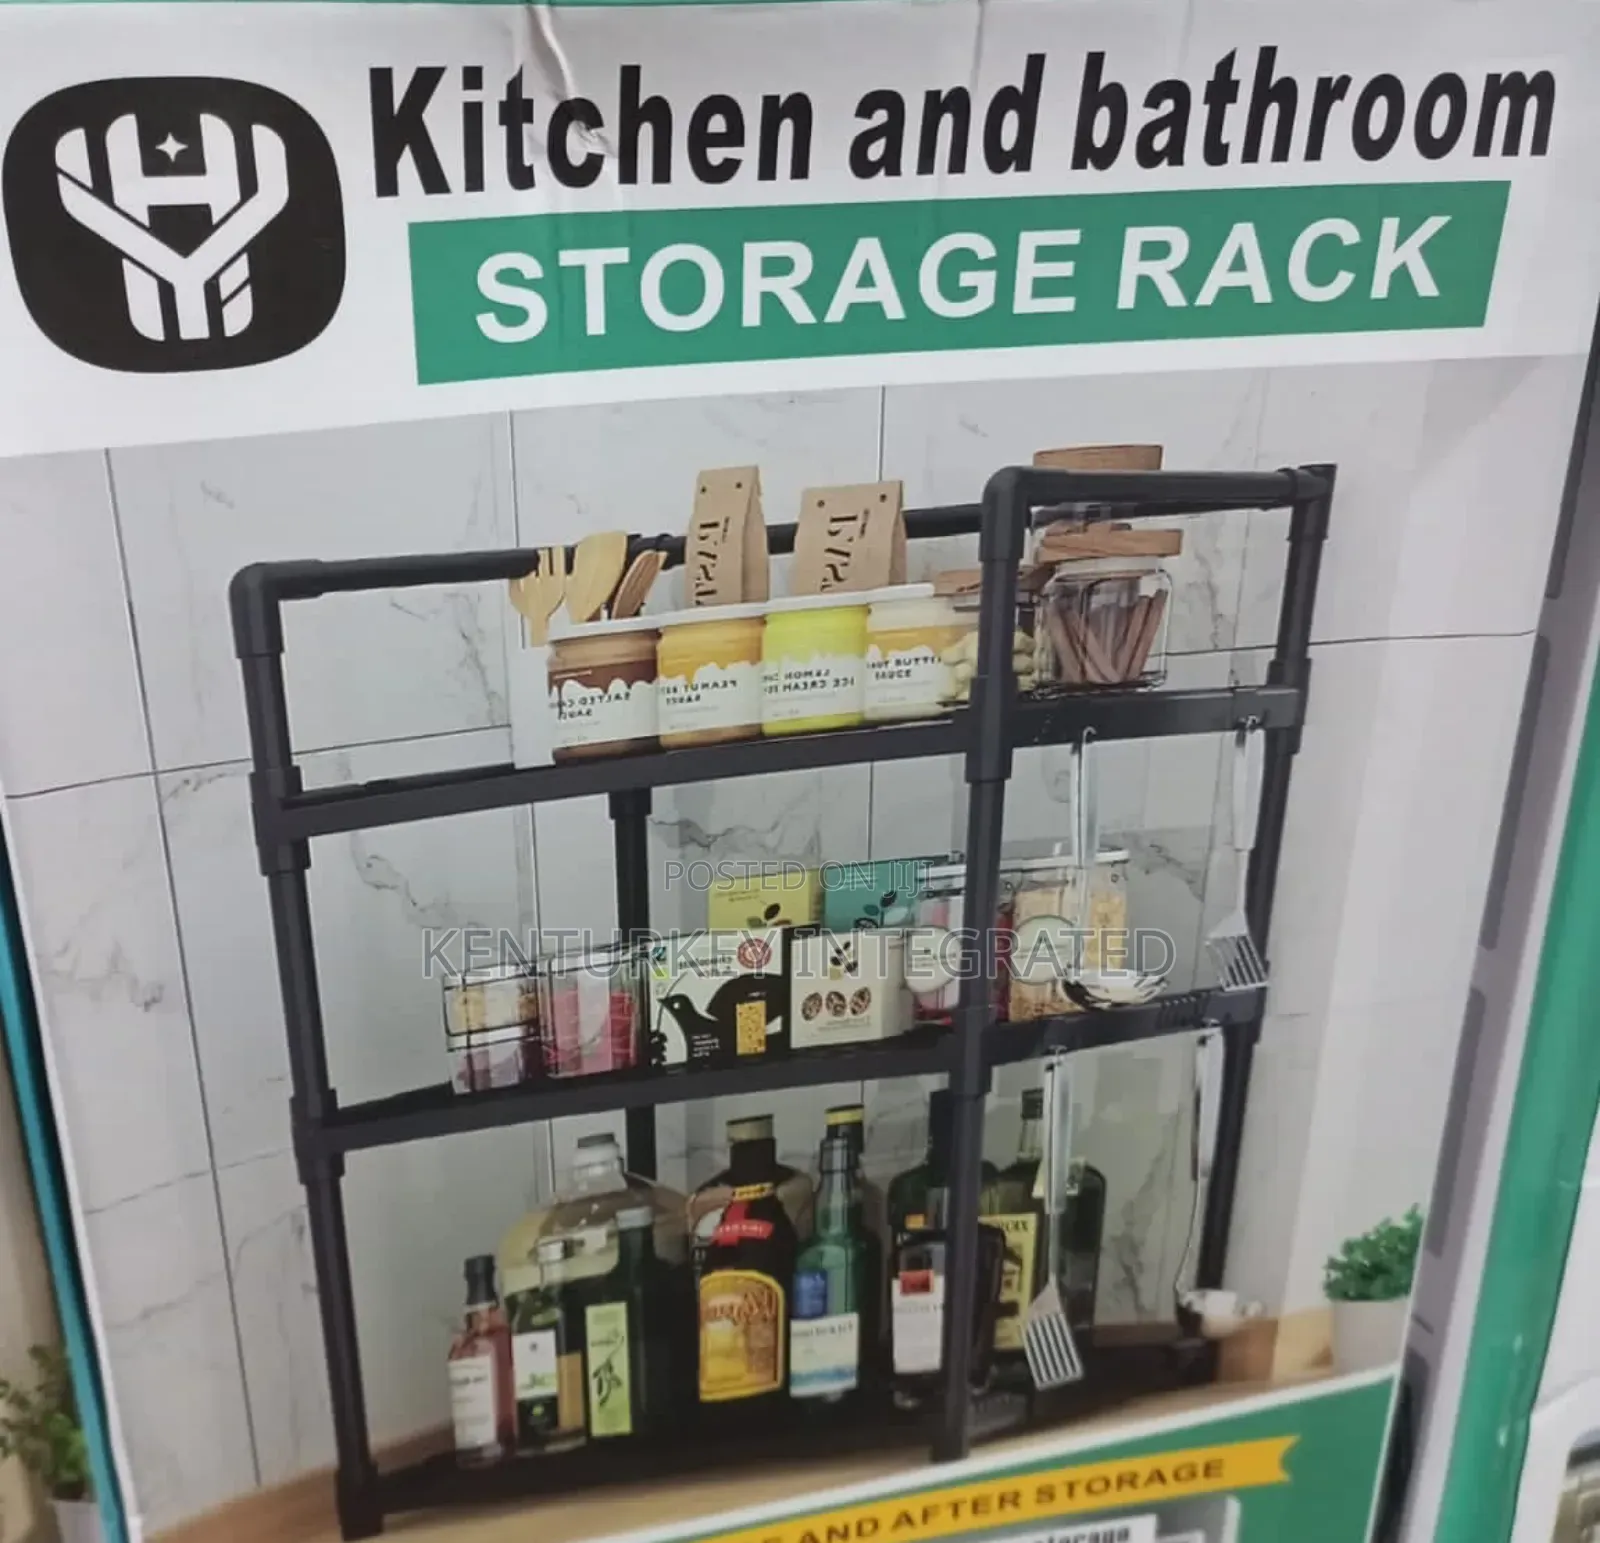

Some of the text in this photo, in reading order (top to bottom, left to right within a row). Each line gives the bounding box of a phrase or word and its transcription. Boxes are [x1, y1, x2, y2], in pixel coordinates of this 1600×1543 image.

[369, 46, 1556, 197] Kitchen and bathroom
[475, 215, 1452, 343] STORAGE RACK
[799, 1458, 1225, 1543] AND AFTER STORAGE
